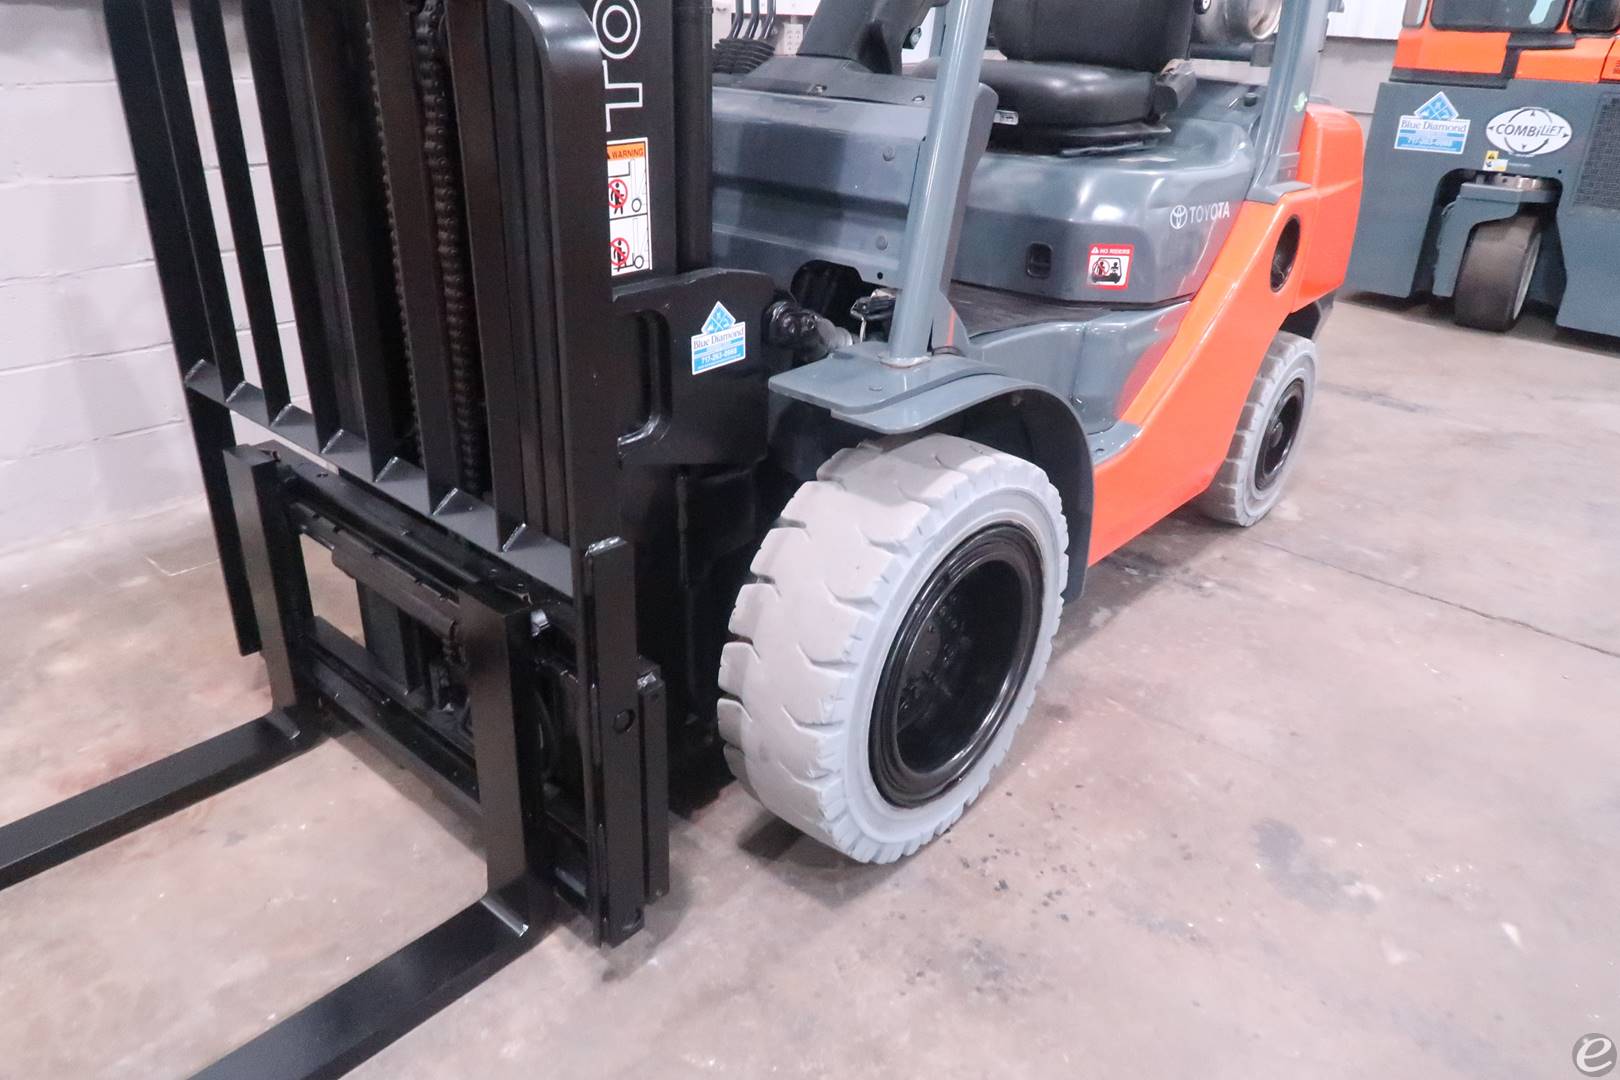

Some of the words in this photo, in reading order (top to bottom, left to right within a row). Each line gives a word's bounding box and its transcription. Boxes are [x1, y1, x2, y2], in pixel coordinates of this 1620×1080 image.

[1401, 120, 1421, 129] Blue
[1423, 121, 1467, 132] Diamond
[611, 147, 644, 159] WARNING
[1189, 201, 1231, 224] TOYOTA
[693, 339, 709, 350] Blue
[711, 326, 744, 345] Diamond
